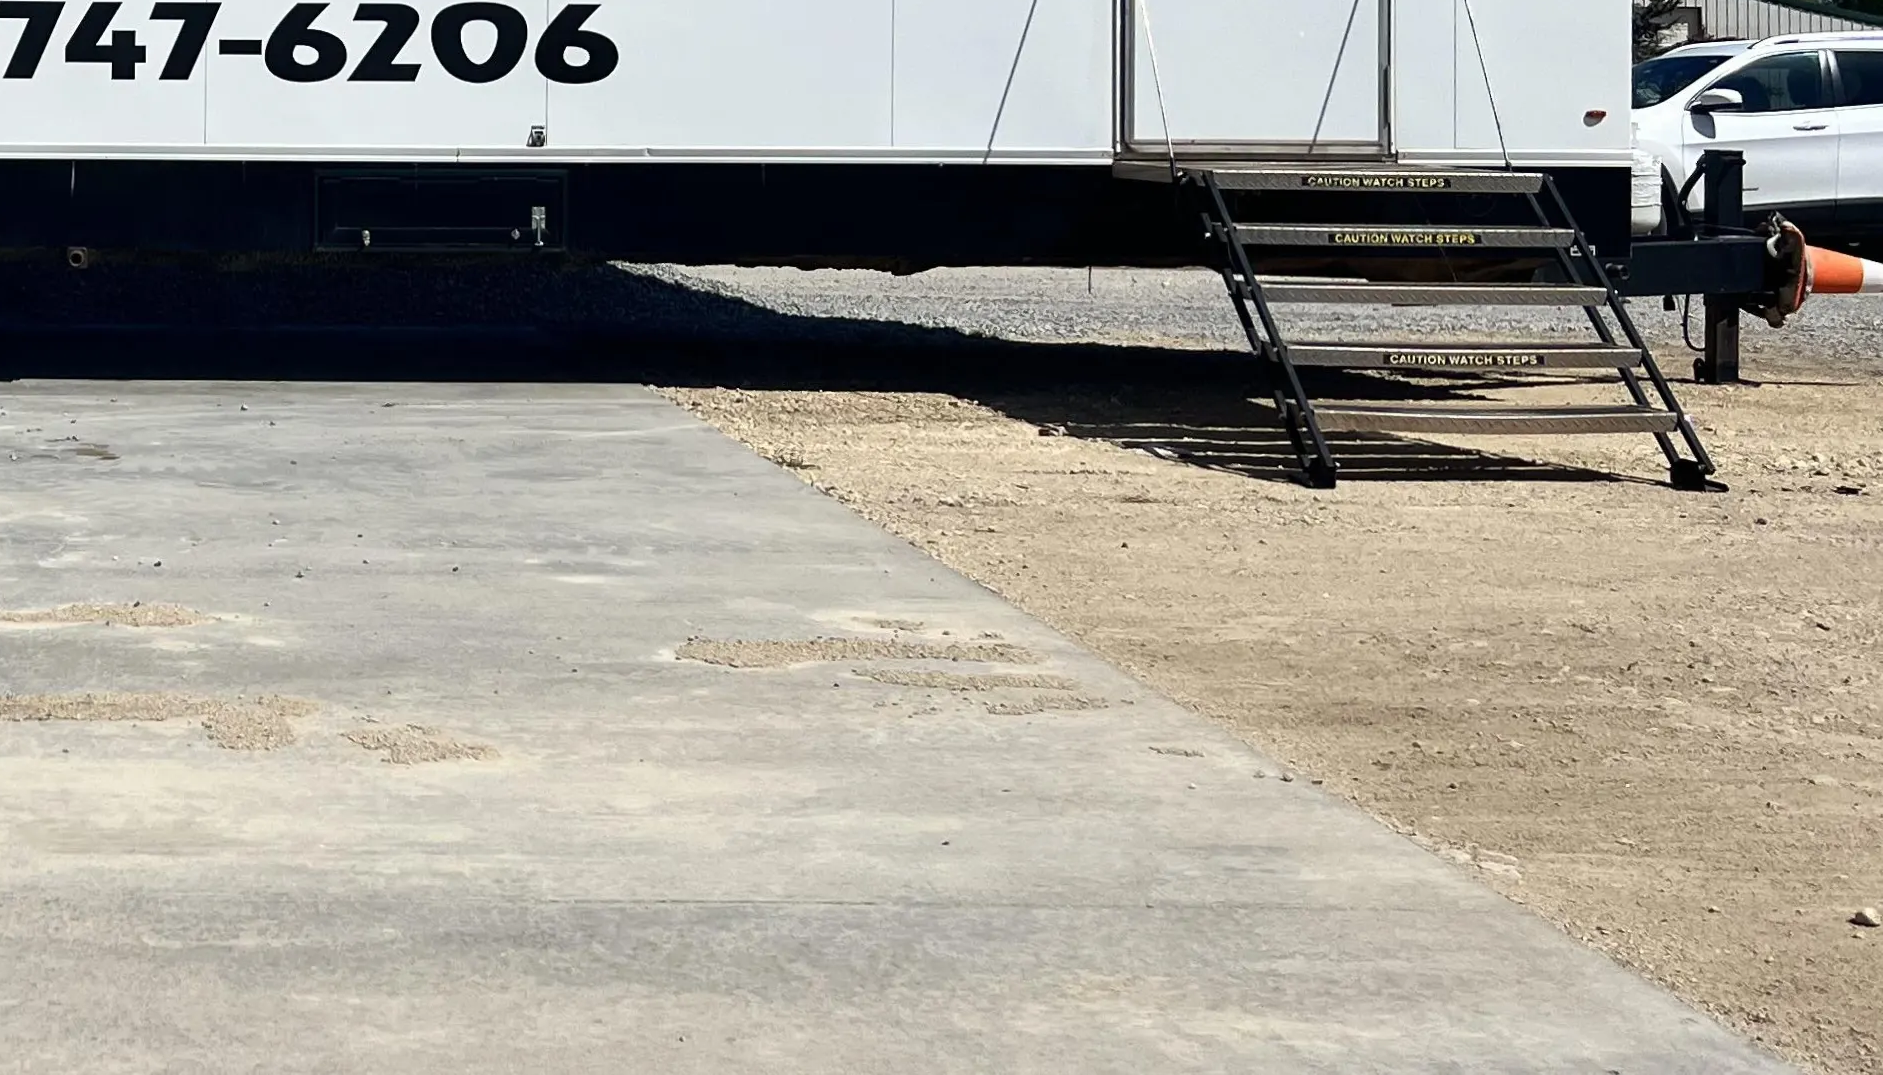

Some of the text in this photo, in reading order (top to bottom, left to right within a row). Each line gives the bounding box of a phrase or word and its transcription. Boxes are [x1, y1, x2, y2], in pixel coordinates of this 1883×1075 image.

[1308, 177, 1445, 188] CAUTION WATCH STEPS
[1335, 234, 1475, 244] CAUTION WATCH STEPS
[1390, 354, 1537, 365] CAUTION WATCH STEPS
